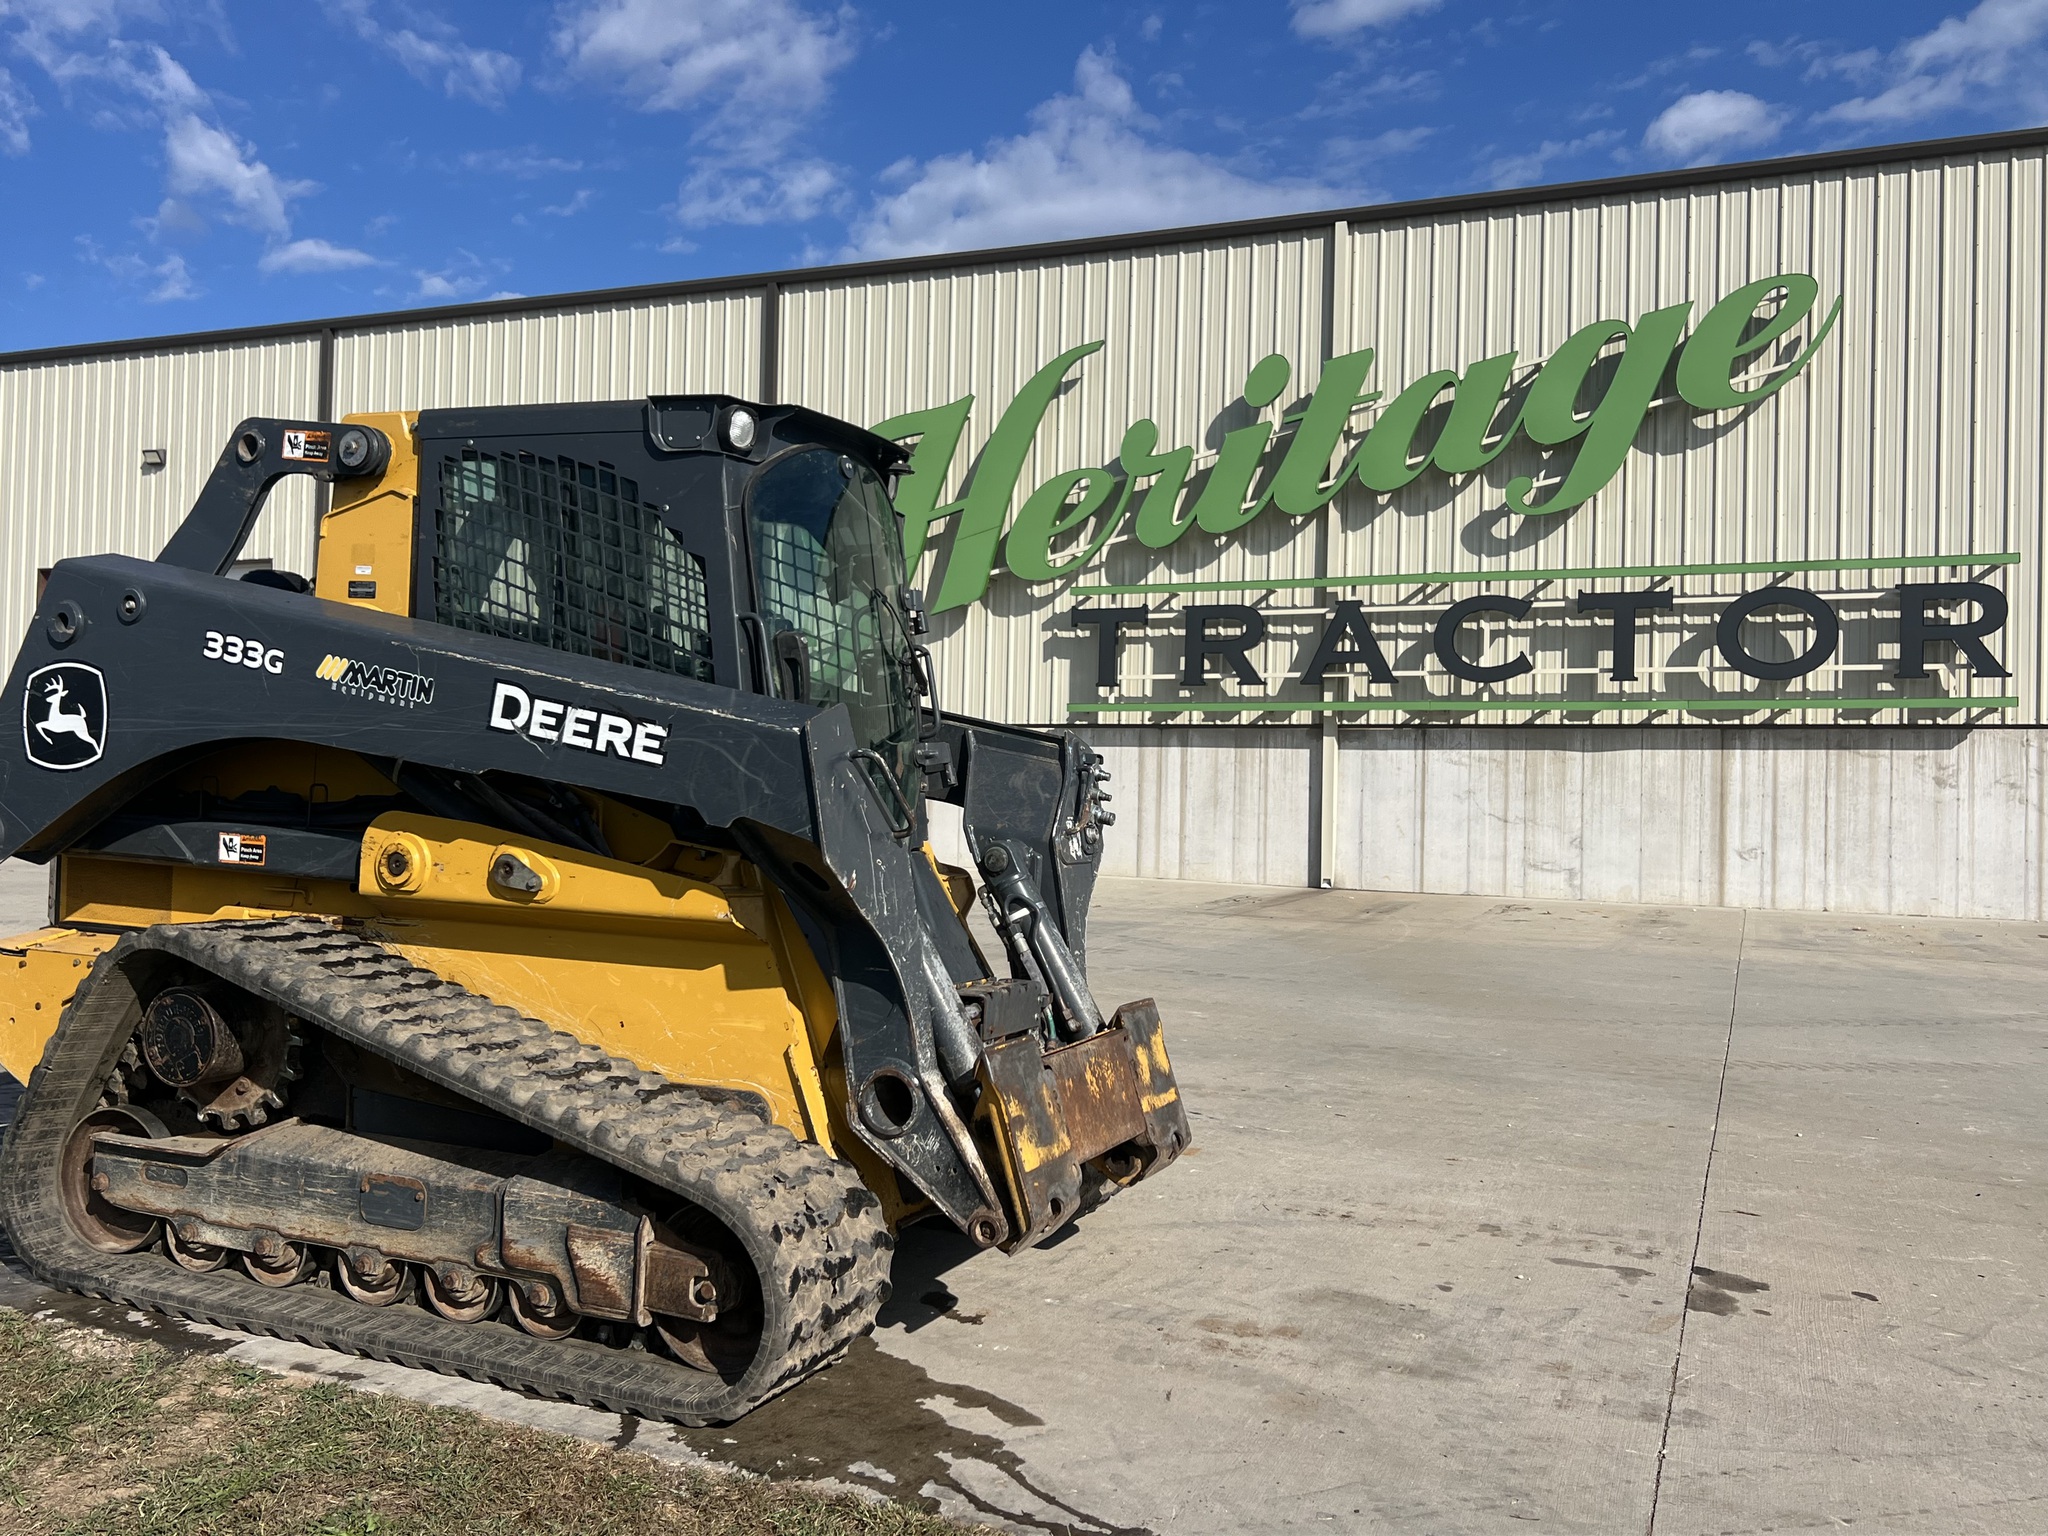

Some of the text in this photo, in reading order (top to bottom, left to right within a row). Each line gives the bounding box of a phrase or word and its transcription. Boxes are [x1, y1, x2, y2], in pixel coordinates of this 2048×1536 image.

[868, 273, 1842, 616] Heritage
[203, 631, 285, 674] 333G
[1071, 582, 2013, 688] TRACTOR
[340, 660, 434, 704] MARTIN
[490, 682, 667, 765] DEERE
